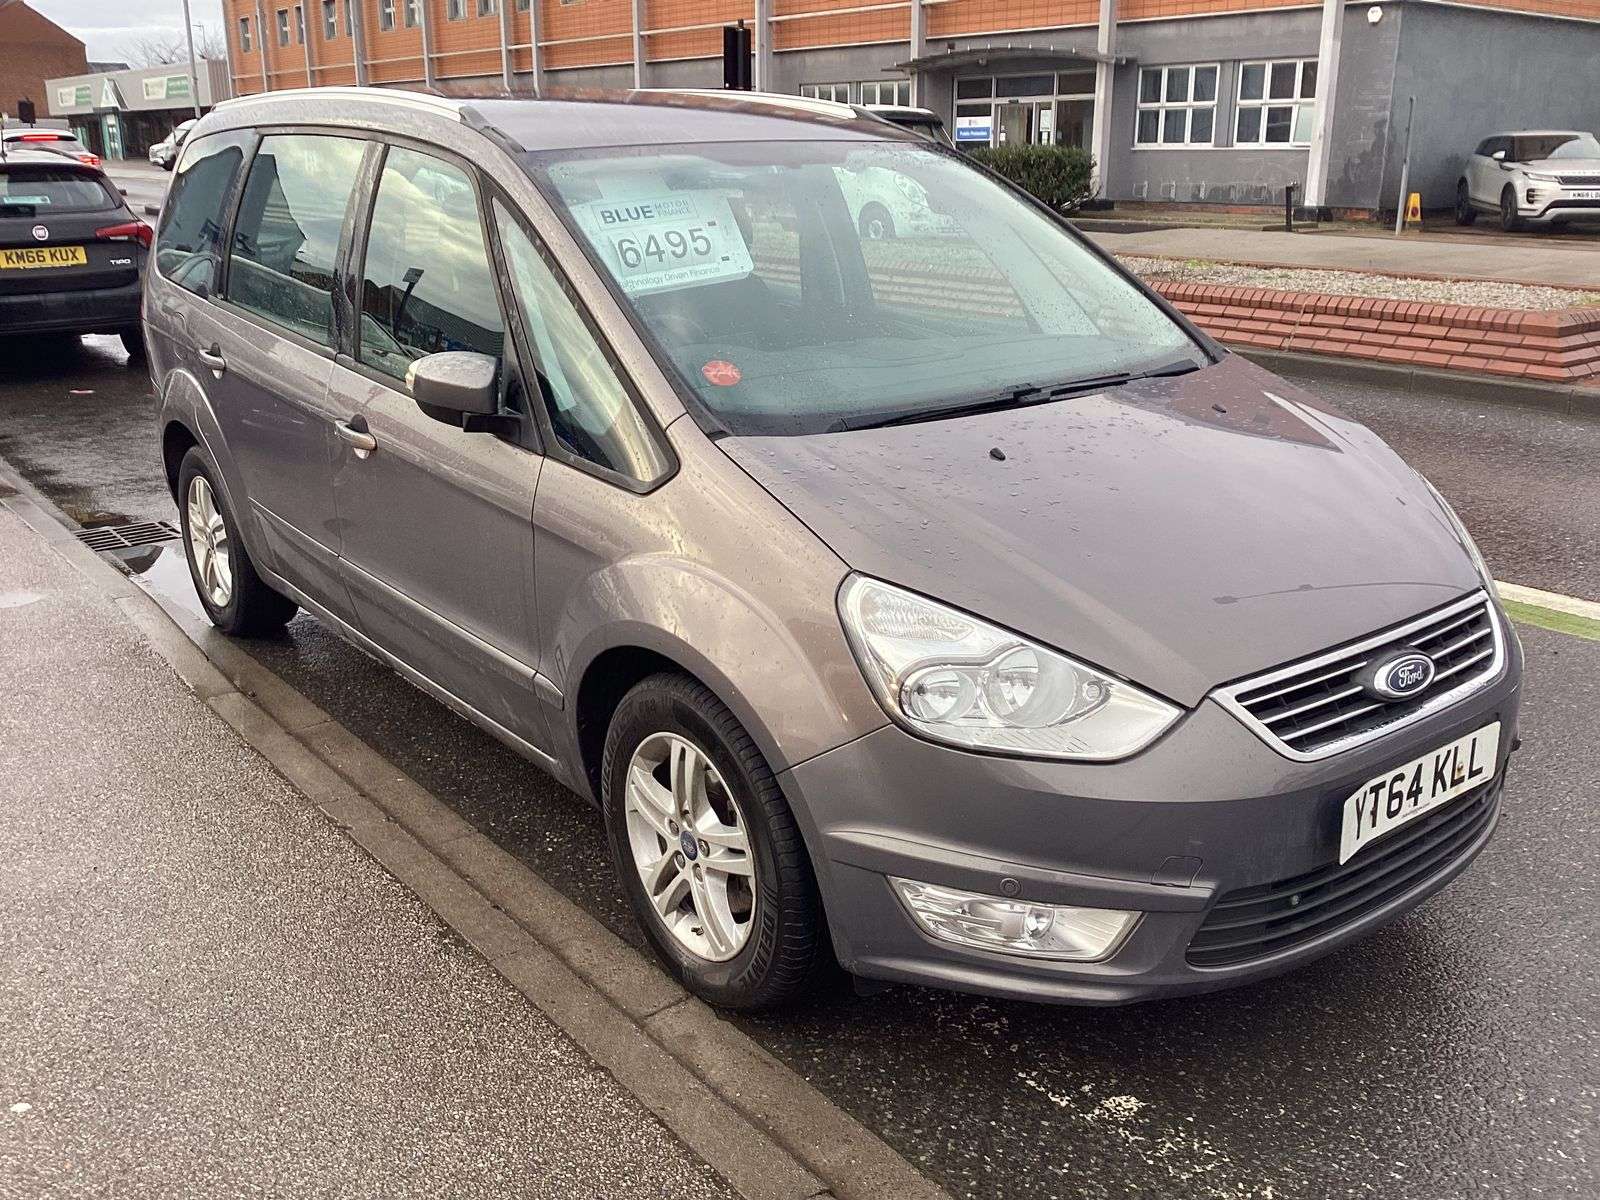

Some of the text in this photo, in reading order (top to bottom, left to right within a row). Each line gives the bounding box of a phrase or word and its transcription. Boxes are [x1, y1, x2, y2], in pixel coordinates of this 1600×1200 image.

[600, 204, 655, 225] BLUE
[654, 199, 689, 210] MOTOR
[4, 248, 81, 265] KM66 KUX
[617, 228, 712, 268] 6495
[664, 271, 689, 282] Driven
[1398, 664, 1425, 688] Ford
[1355, 737, 1484, 840] YT64 KLL
